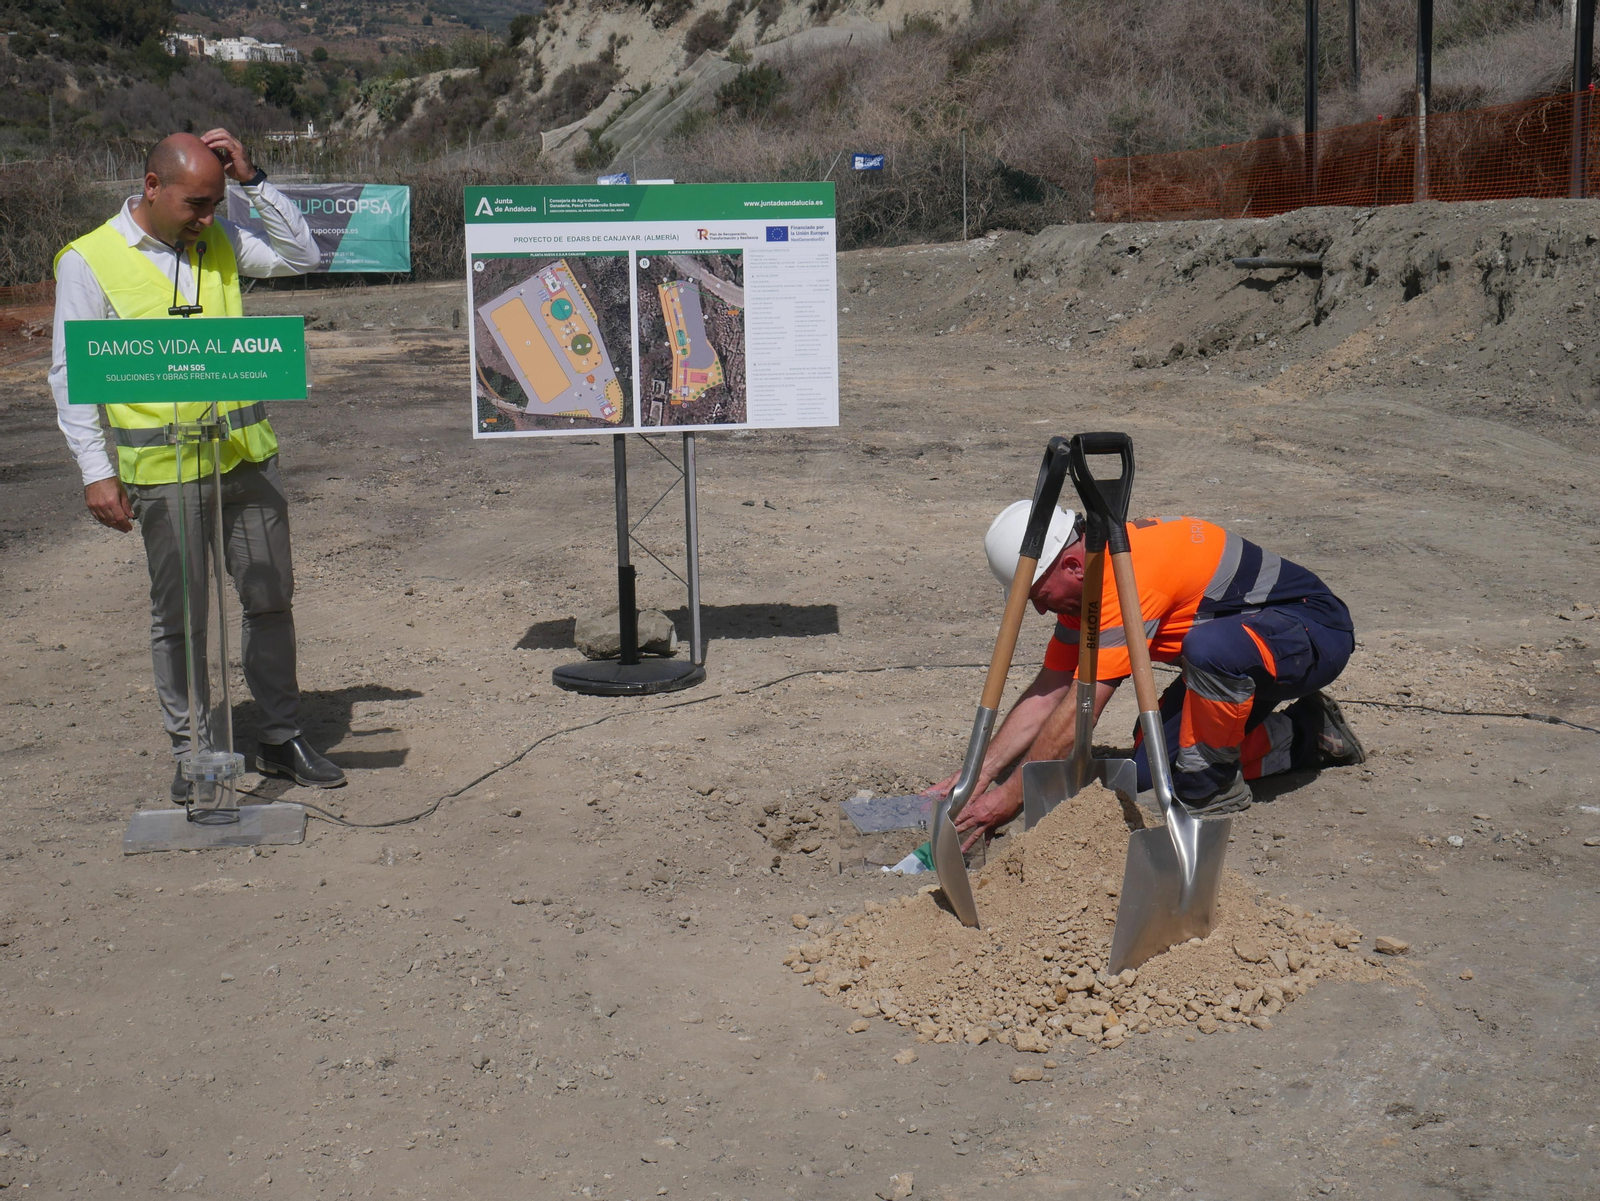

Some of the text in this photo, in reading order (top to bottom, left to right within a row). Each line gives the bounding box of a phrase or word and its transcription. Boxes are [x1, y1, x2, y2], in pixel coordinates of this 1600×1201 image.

[291, 199, 392, 215] UPOCOPSA
[88, 338, 282, 356] DAMOS VIDA AL AGUA
[240, 370, 267, 378] SEQUÍA
[1086, 601, 1099, 649] BELLOTA
